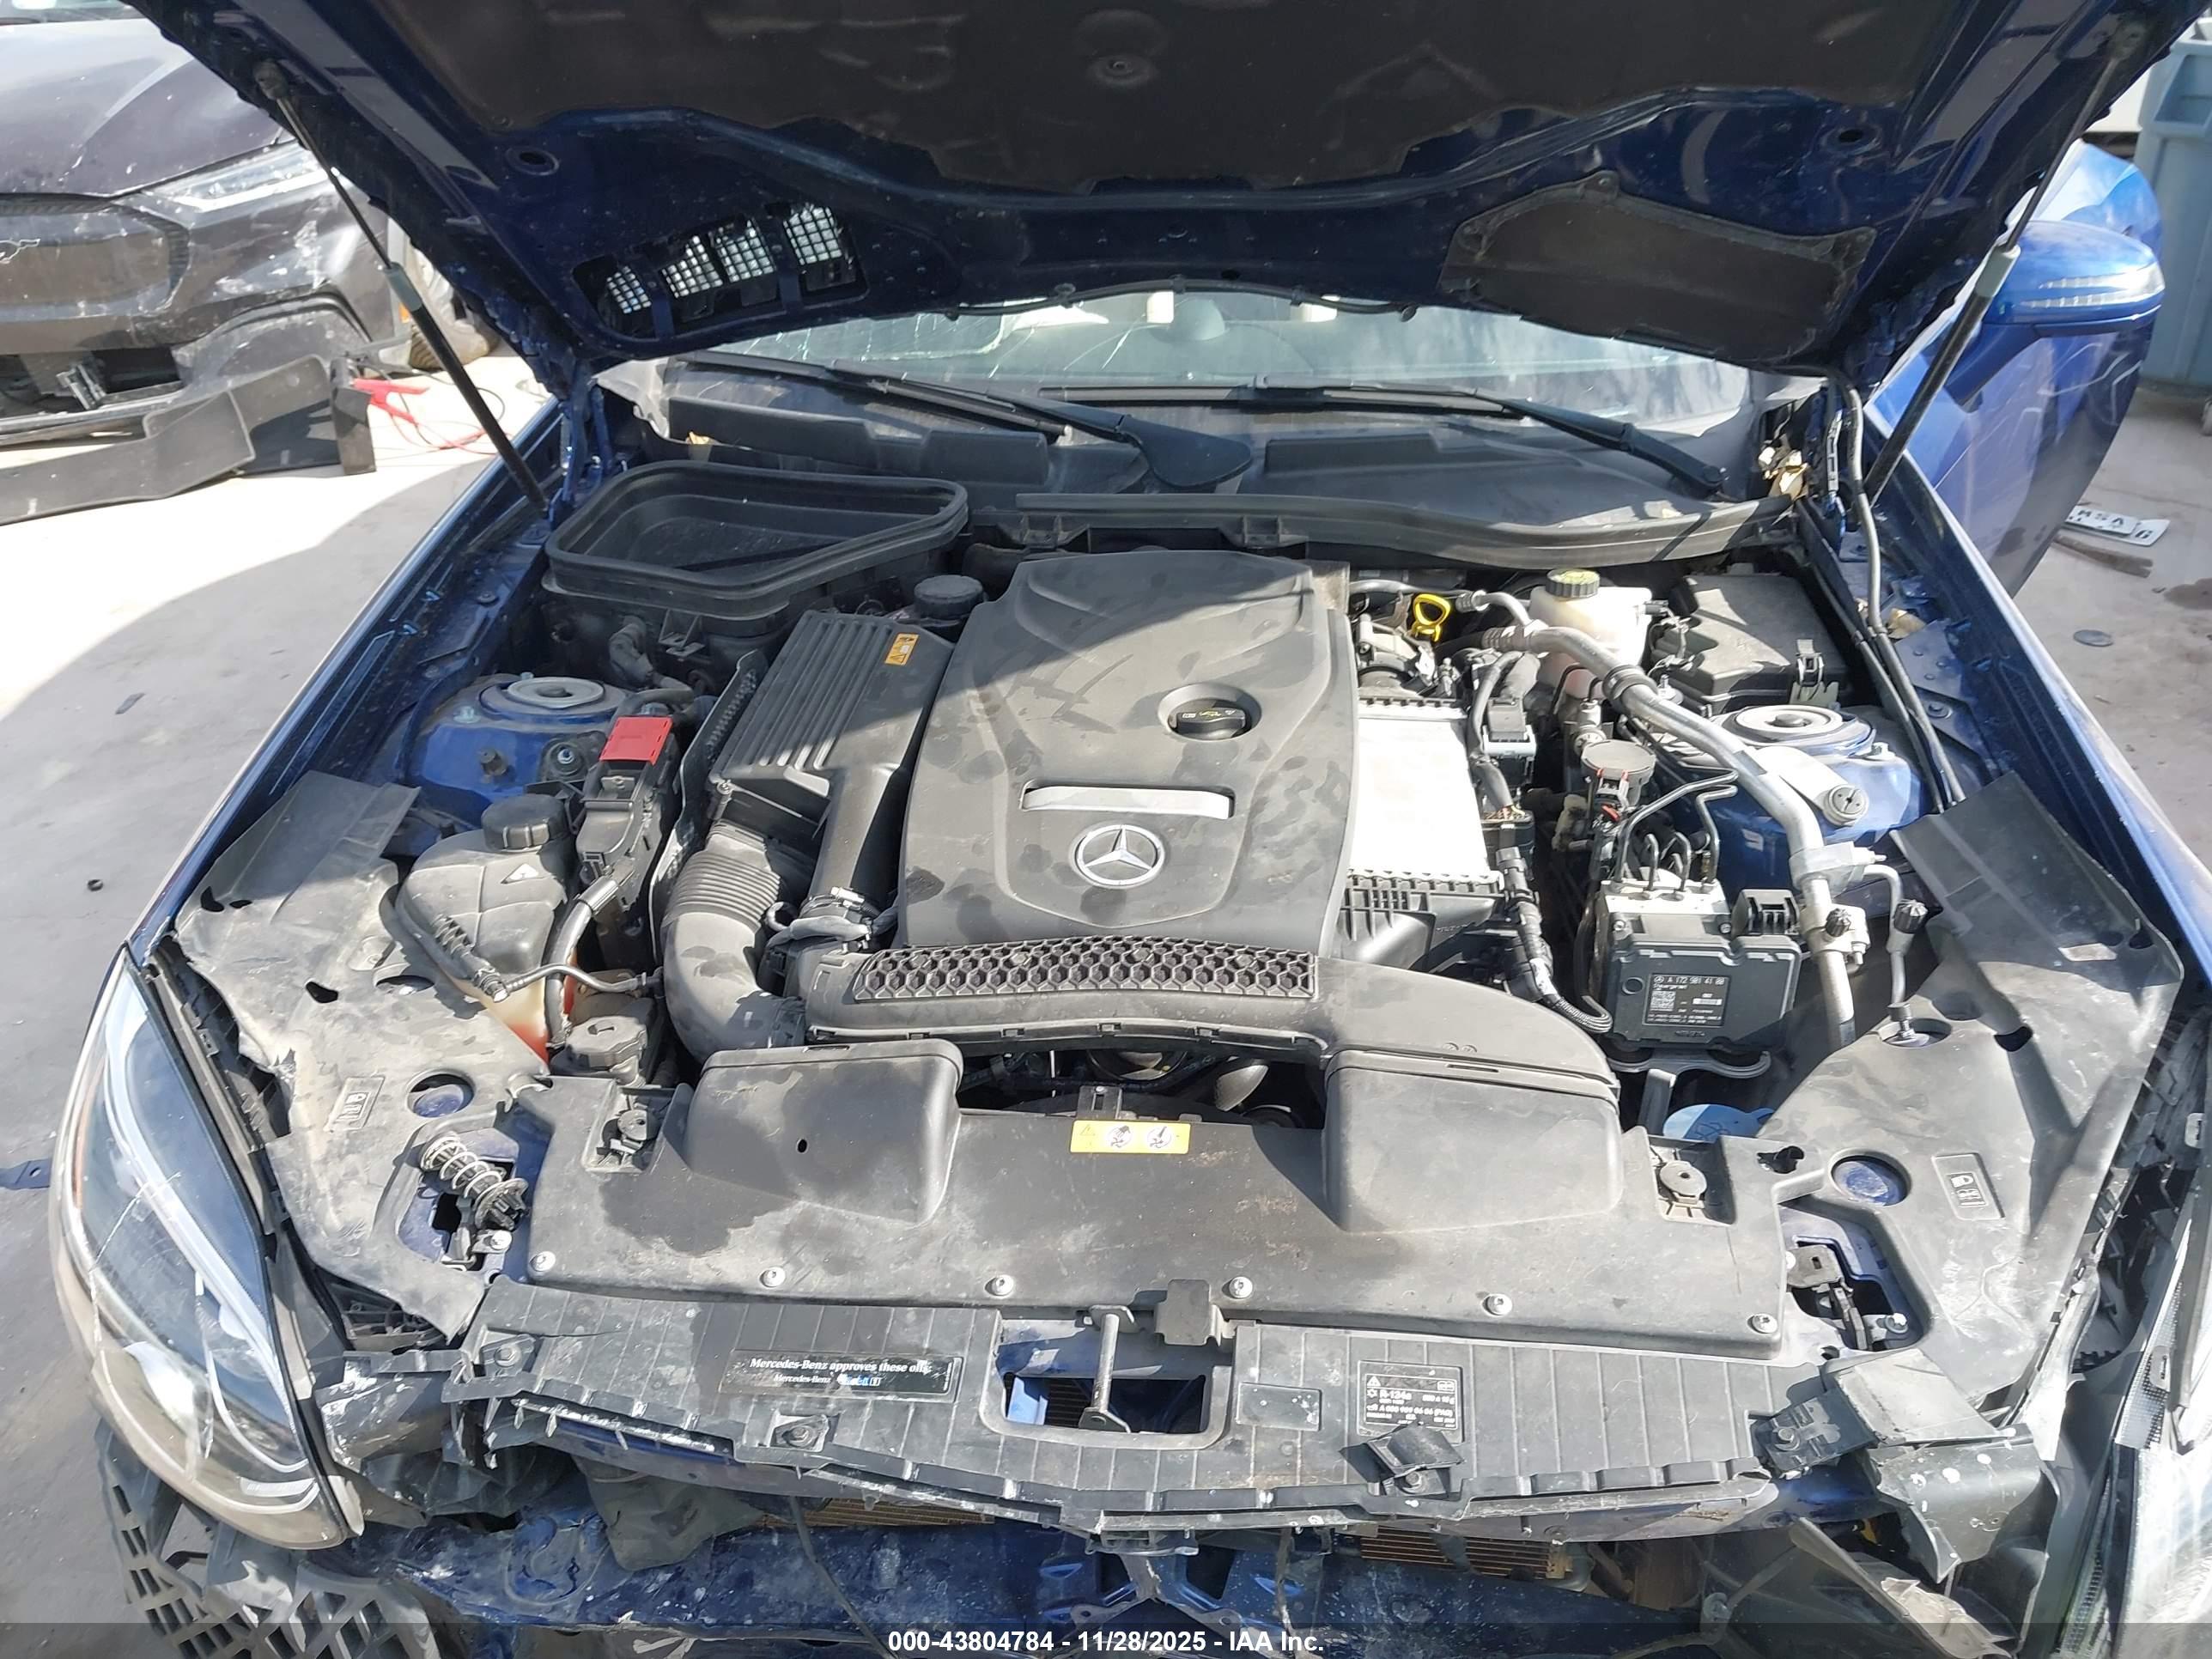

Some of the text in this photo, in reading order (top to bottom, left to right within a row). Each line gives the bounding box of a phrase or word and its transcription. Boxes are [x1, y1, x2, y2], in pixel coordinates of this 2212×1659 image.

[749, 1358, 829, 1370] Mercedes-Benz
[829, 1361, 877, 1373] approves
[878, 1361, 908, 1372] these
[773, 1374, 832, 1384] Mercedes-Benz
